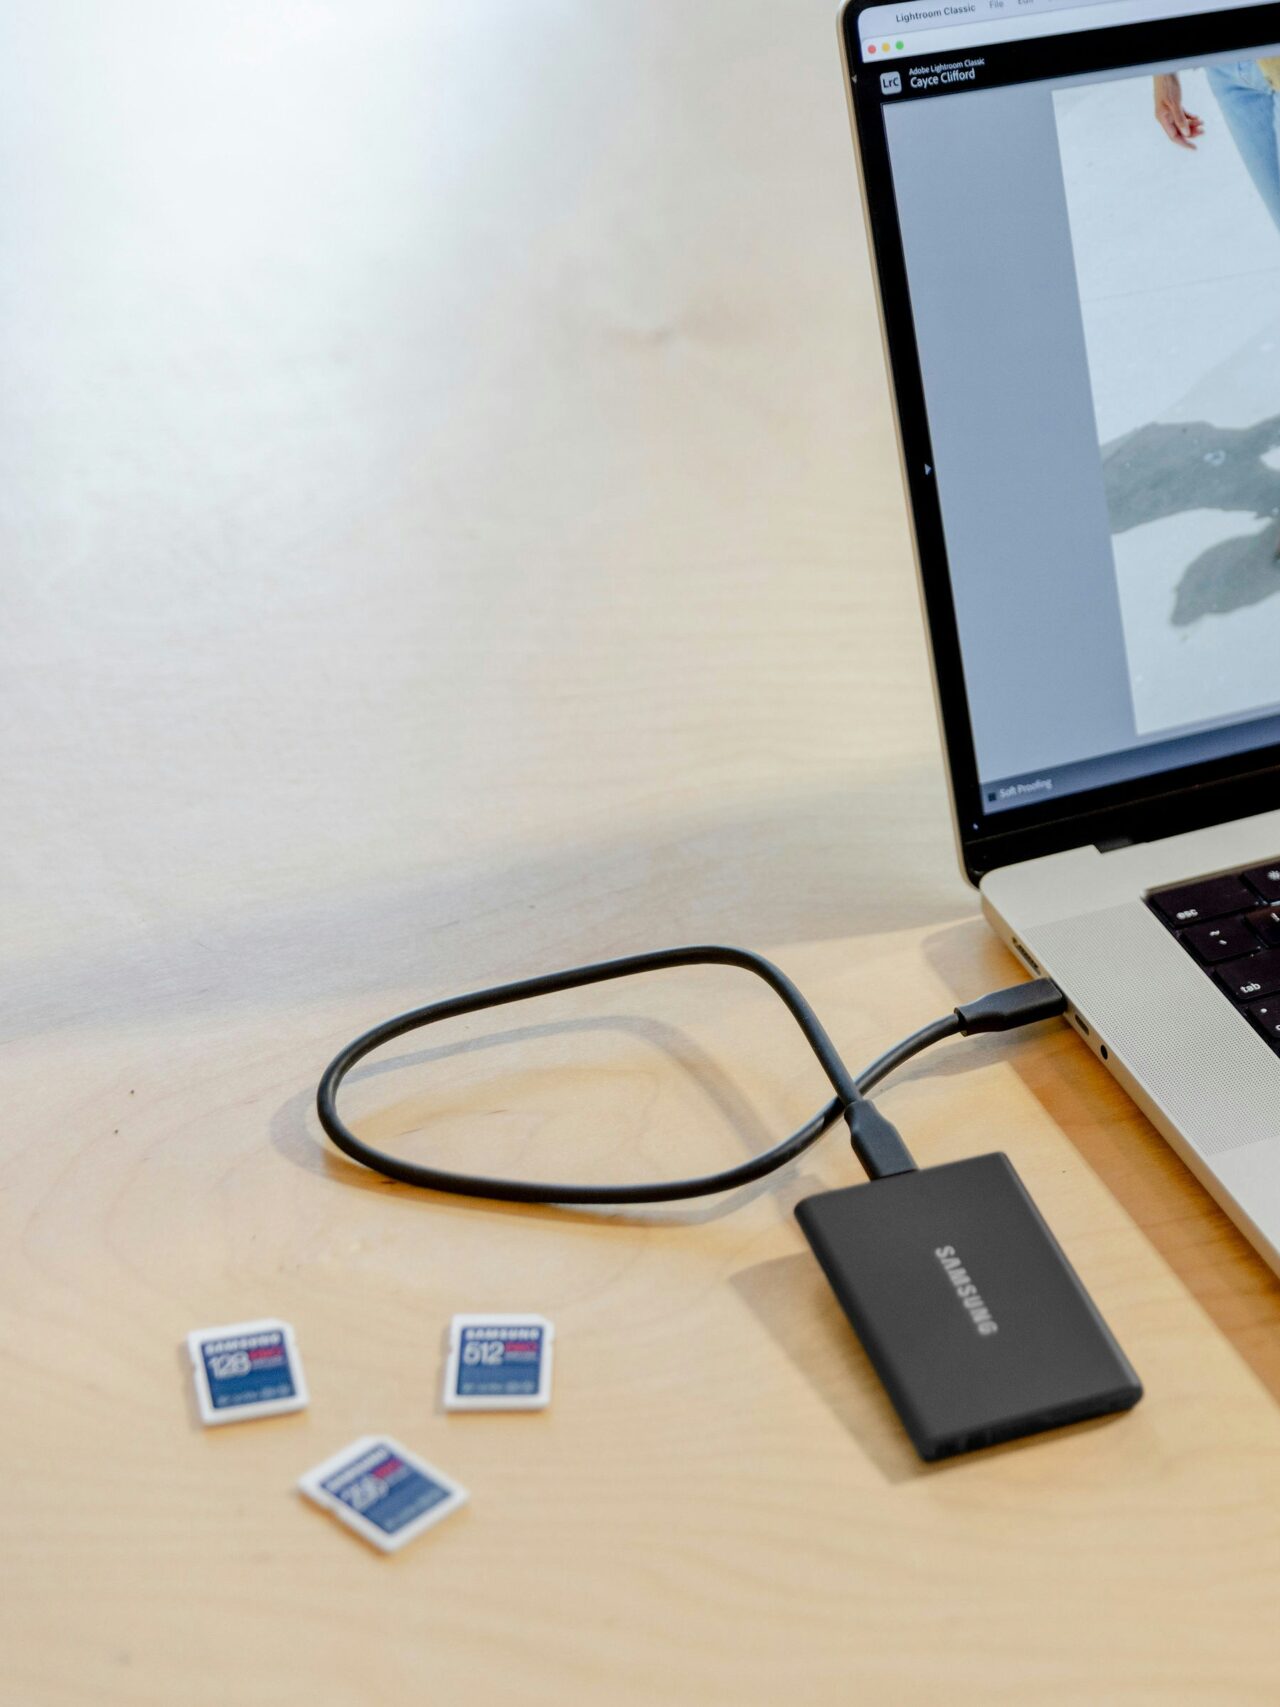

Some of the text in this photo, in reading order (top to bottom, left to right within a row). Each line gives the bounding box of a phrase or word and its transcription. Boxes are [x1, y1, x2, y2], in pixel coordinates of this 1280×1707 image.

[896, 4, 976, 24] Lightroom Classic
[908, 57, 985, 76] Adobe Lightroom Classic
[882, 76, 900, 88] LrC
[910, 68, 976, 88] Cayce Clifford
[1176, 908, 1199, 920] esc
[1240, 982, 1261, 994] tab
[933, 1245, 998, 1336] SAMSUNG
